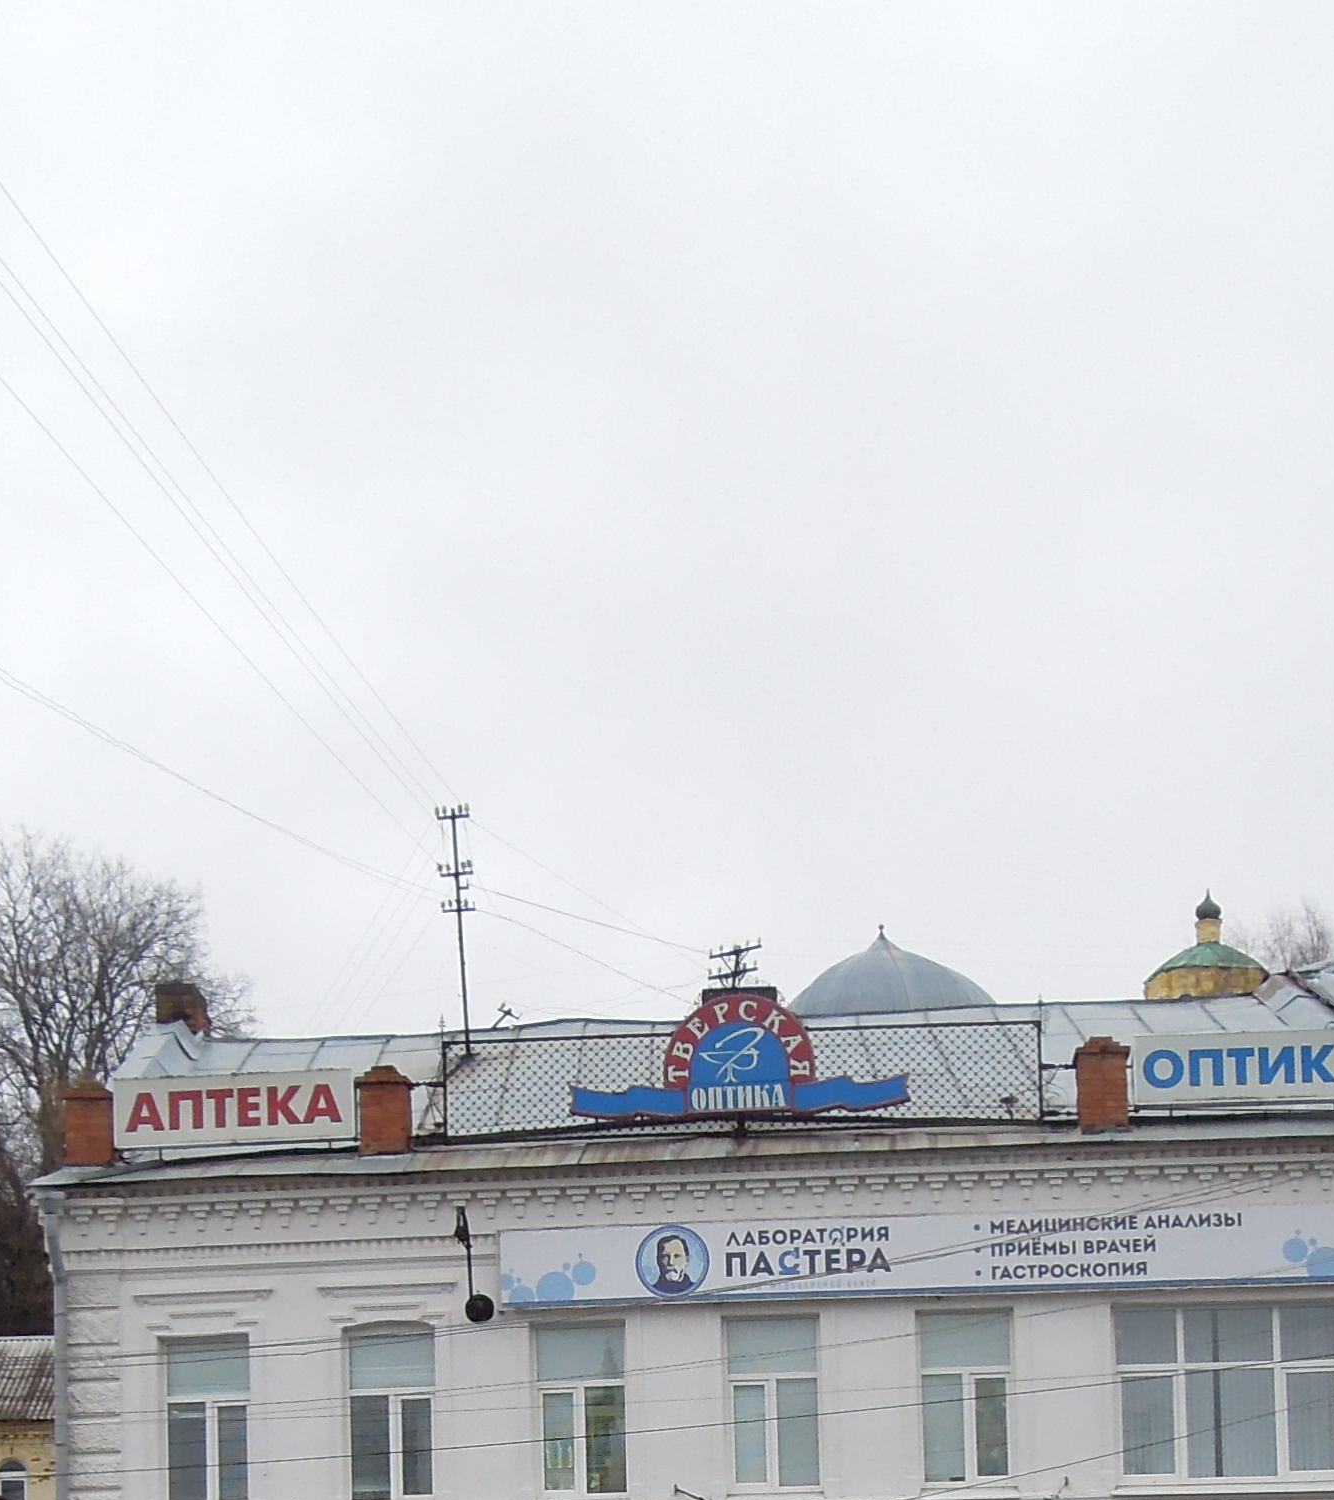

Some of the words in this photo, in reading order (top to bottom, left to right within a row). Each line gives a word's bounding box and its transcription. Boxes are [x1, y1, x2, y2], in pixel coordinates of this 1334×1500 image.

[667, 999, 811, 1084] ТВЕРСКАЯ
[125, 1083, 343, 1133] АПТЕКА
[691, 1083, 787, 1111] ОПТИКА
[726, 1226, 890, 1247] ЛАБОРАТОРИЯ
[989, 1214, 1139, 1235] МЕДИЦИНСКИЕ
[1144, 1212, 1243, 1230] АНАЛИЗЫ
[990, 1238, 1077, 1258] ПРИЁМЫ
[1083, 1234, 1157, 1254] ВРАЧЕЙ
[725, 1247, 892, 1277] ПАСТЕРА
[991, 1261, 1149, 1281] ГАСТРОСКОПИЯ
